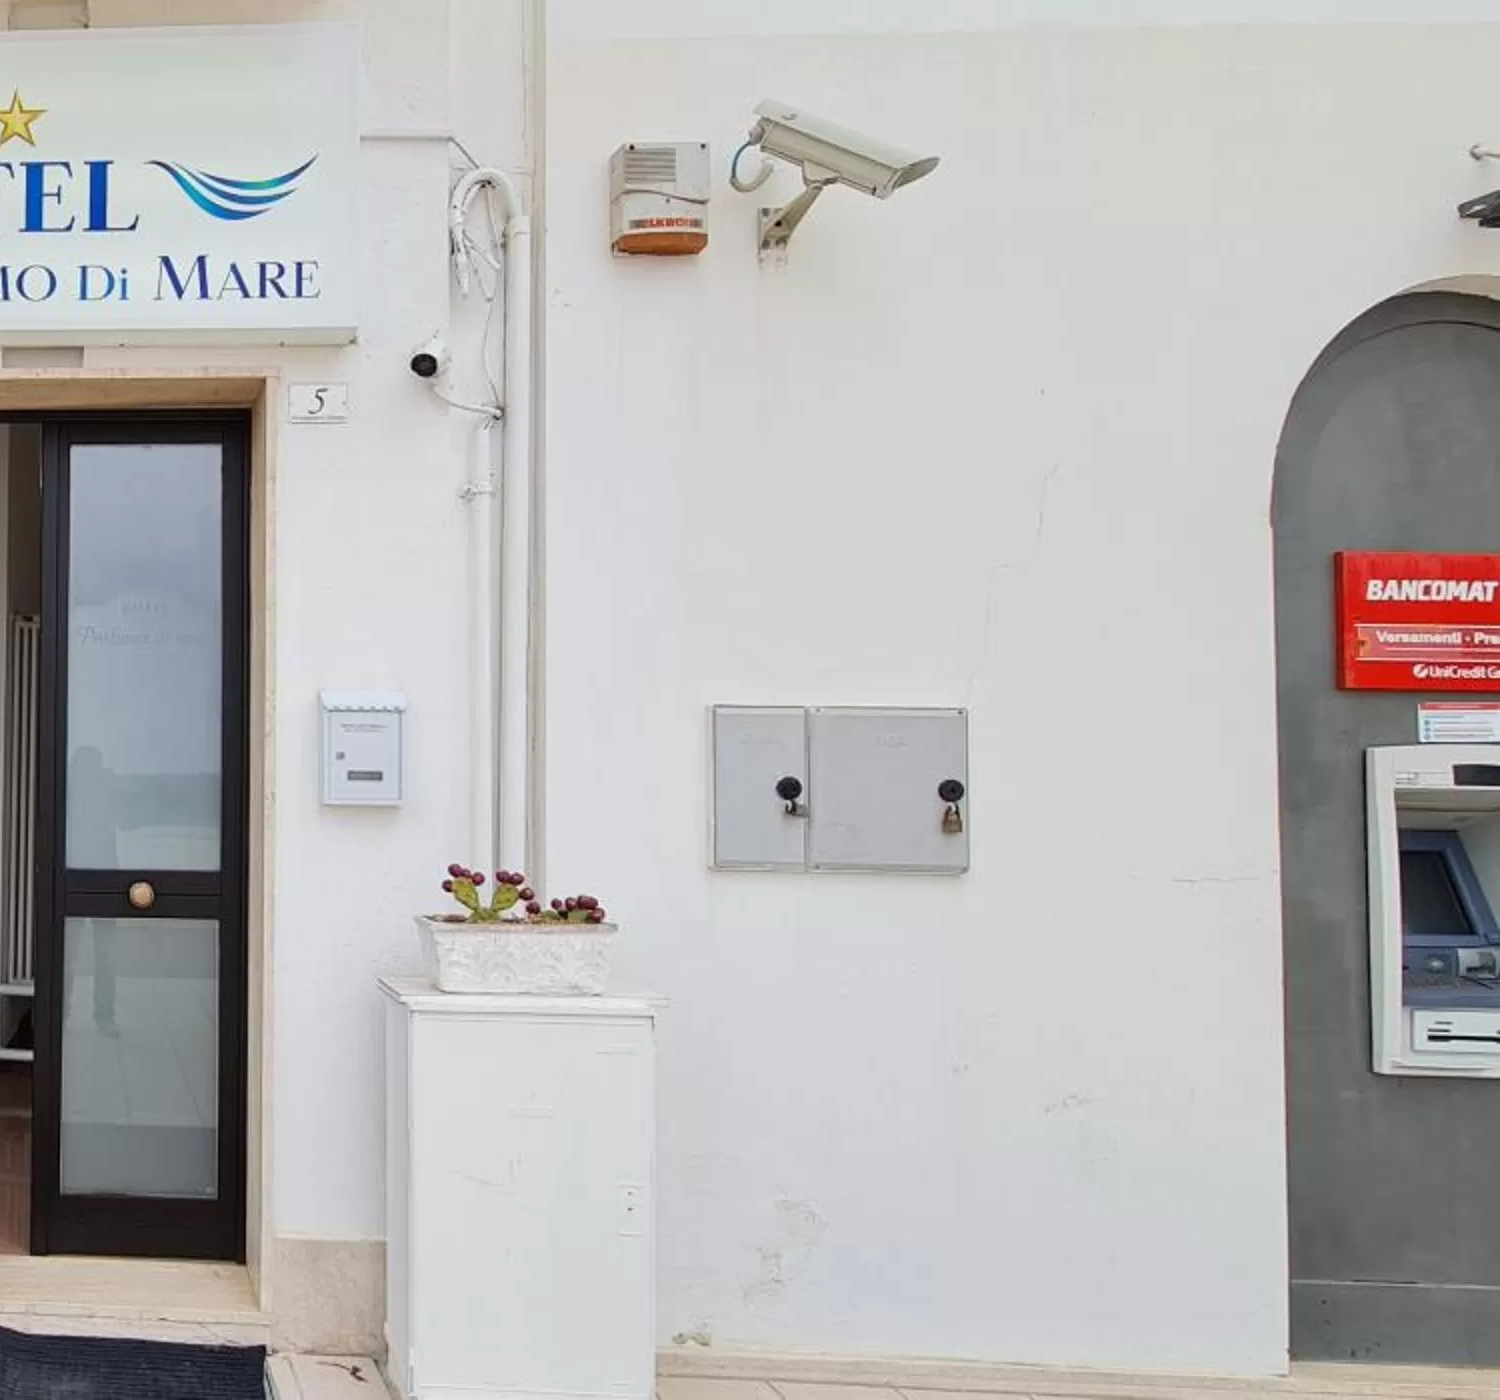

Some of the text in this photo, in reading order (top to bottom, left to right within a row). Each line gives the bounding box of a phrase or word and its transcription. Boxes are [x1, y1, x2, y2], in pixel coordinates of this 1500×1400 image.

[153, 254, 322, 301] MARE
[307, 387, 329, 415] 5
[1366, 579, 1499, 602] BANCOMAT
[1376, 629, 1463, 645] Versamenti
[1429, 663, 1486, 680] UniCredit
